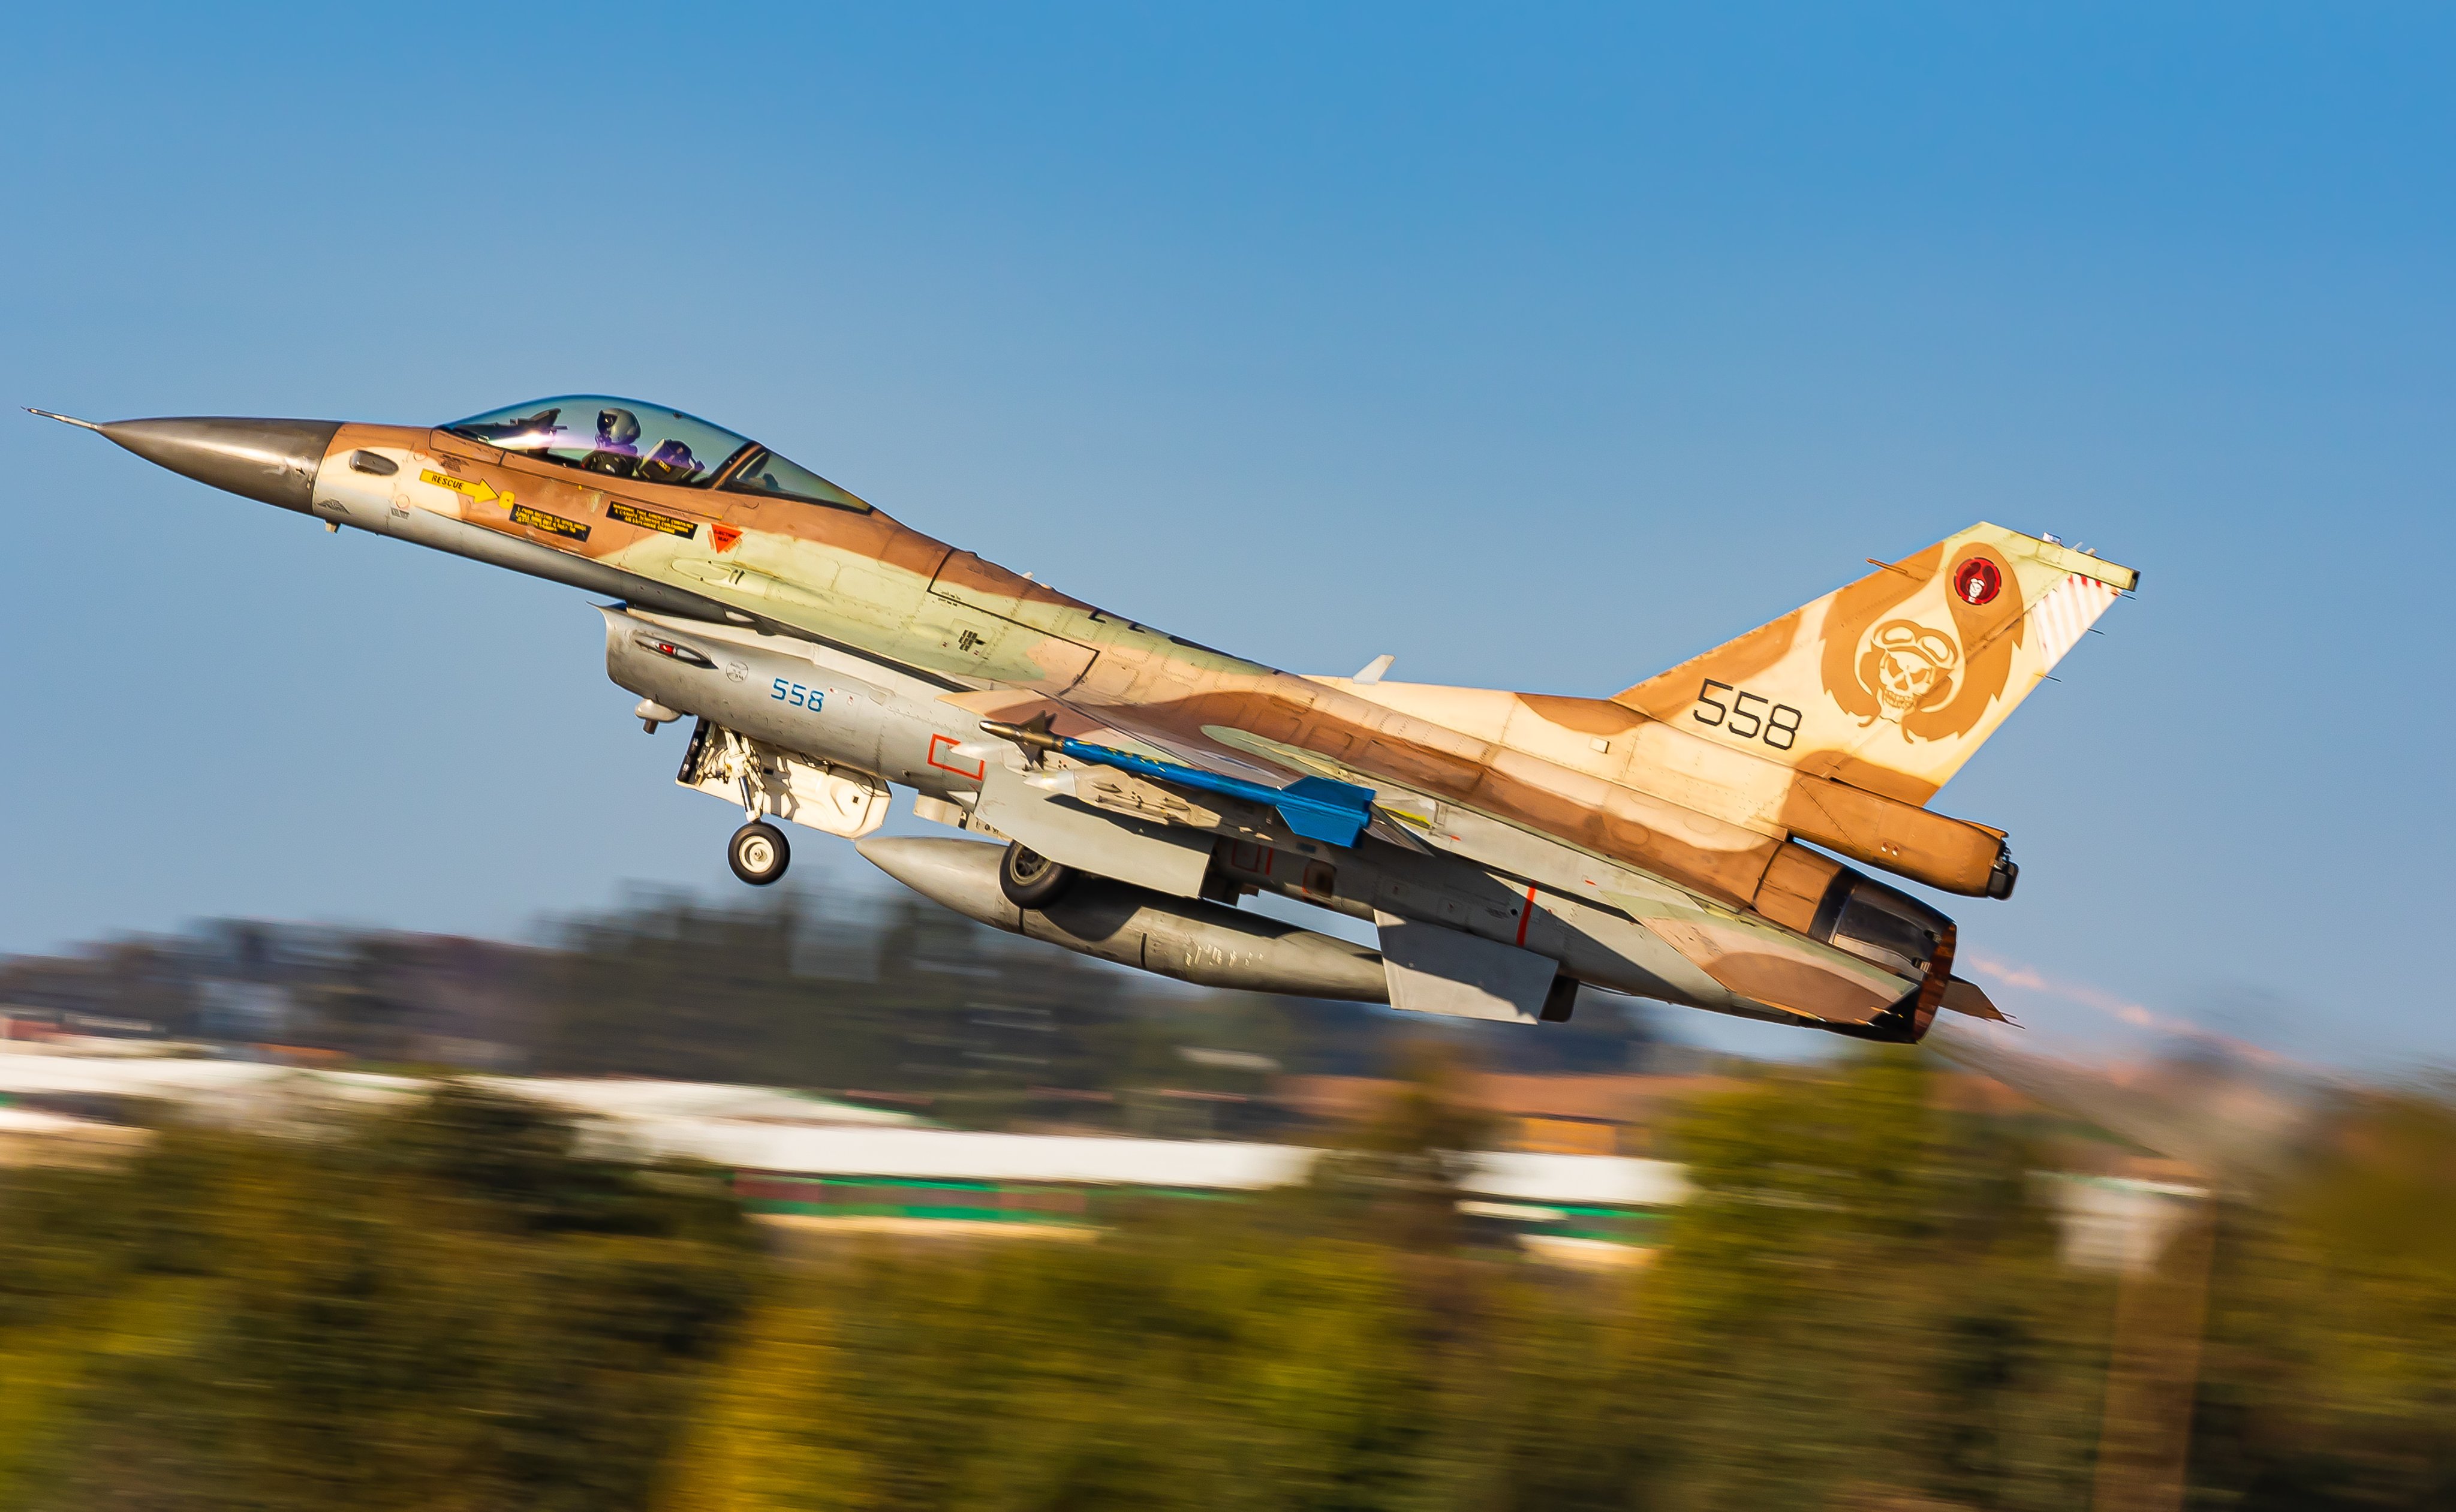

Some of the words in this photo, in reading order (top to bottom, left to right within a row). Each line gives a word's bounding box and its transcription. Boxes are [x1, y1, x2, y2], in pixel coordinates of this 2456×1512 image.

[431, 474, 464, 490] RESCUE
[770, 677, 824, 712] 558
[1693, 678, 1802, 751] 558
